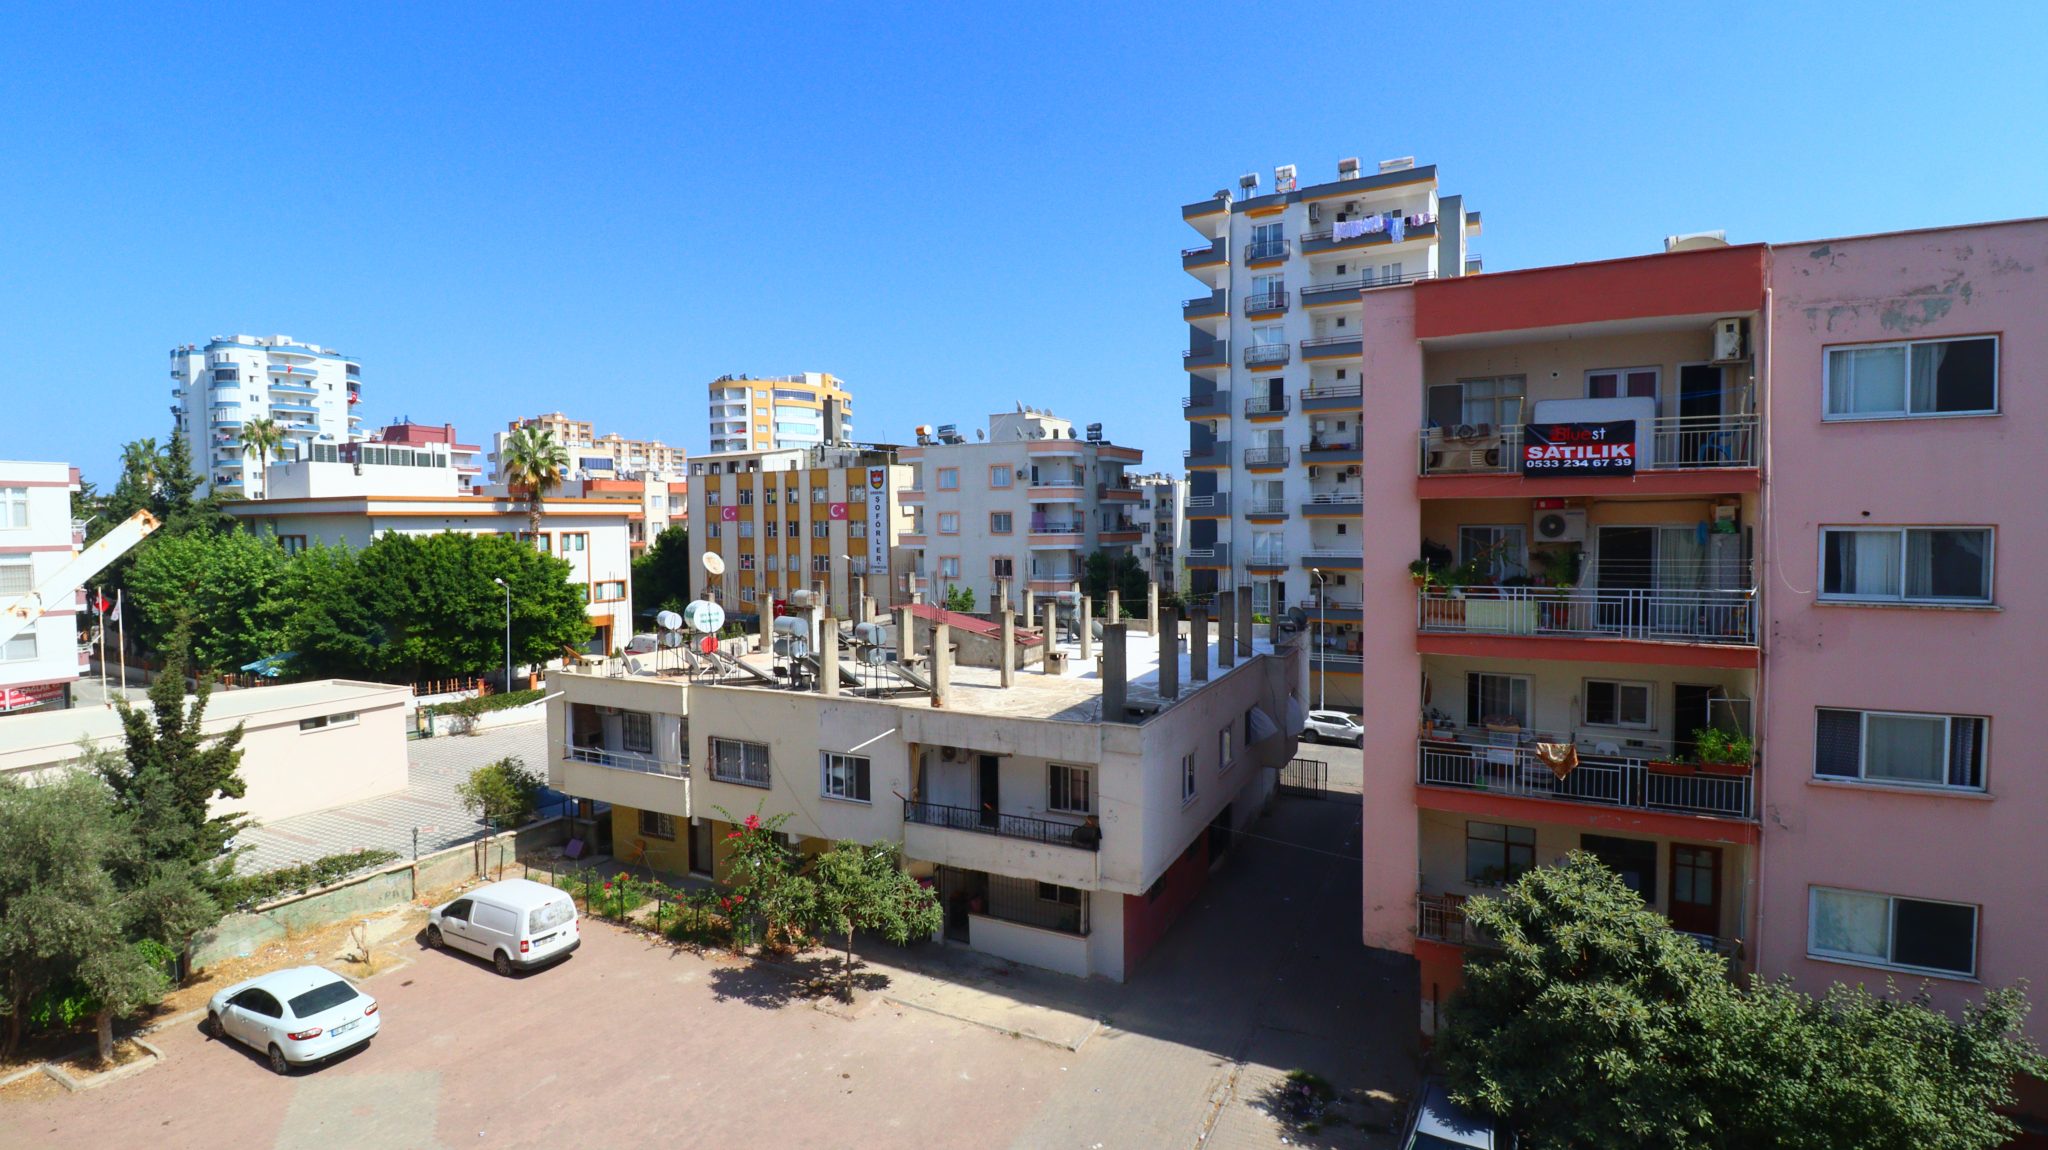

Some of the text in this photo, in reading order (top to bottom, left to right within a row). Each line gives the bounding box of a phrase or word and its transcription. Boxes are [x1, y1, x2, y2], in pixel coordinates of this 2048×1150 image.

[1528, 444, 1630, 459] SATILIK
[1526, 460, 1559, 468] 0533
[1592, 459, 1610, 467] 67
[1614, 458, 1632, 466] 39
